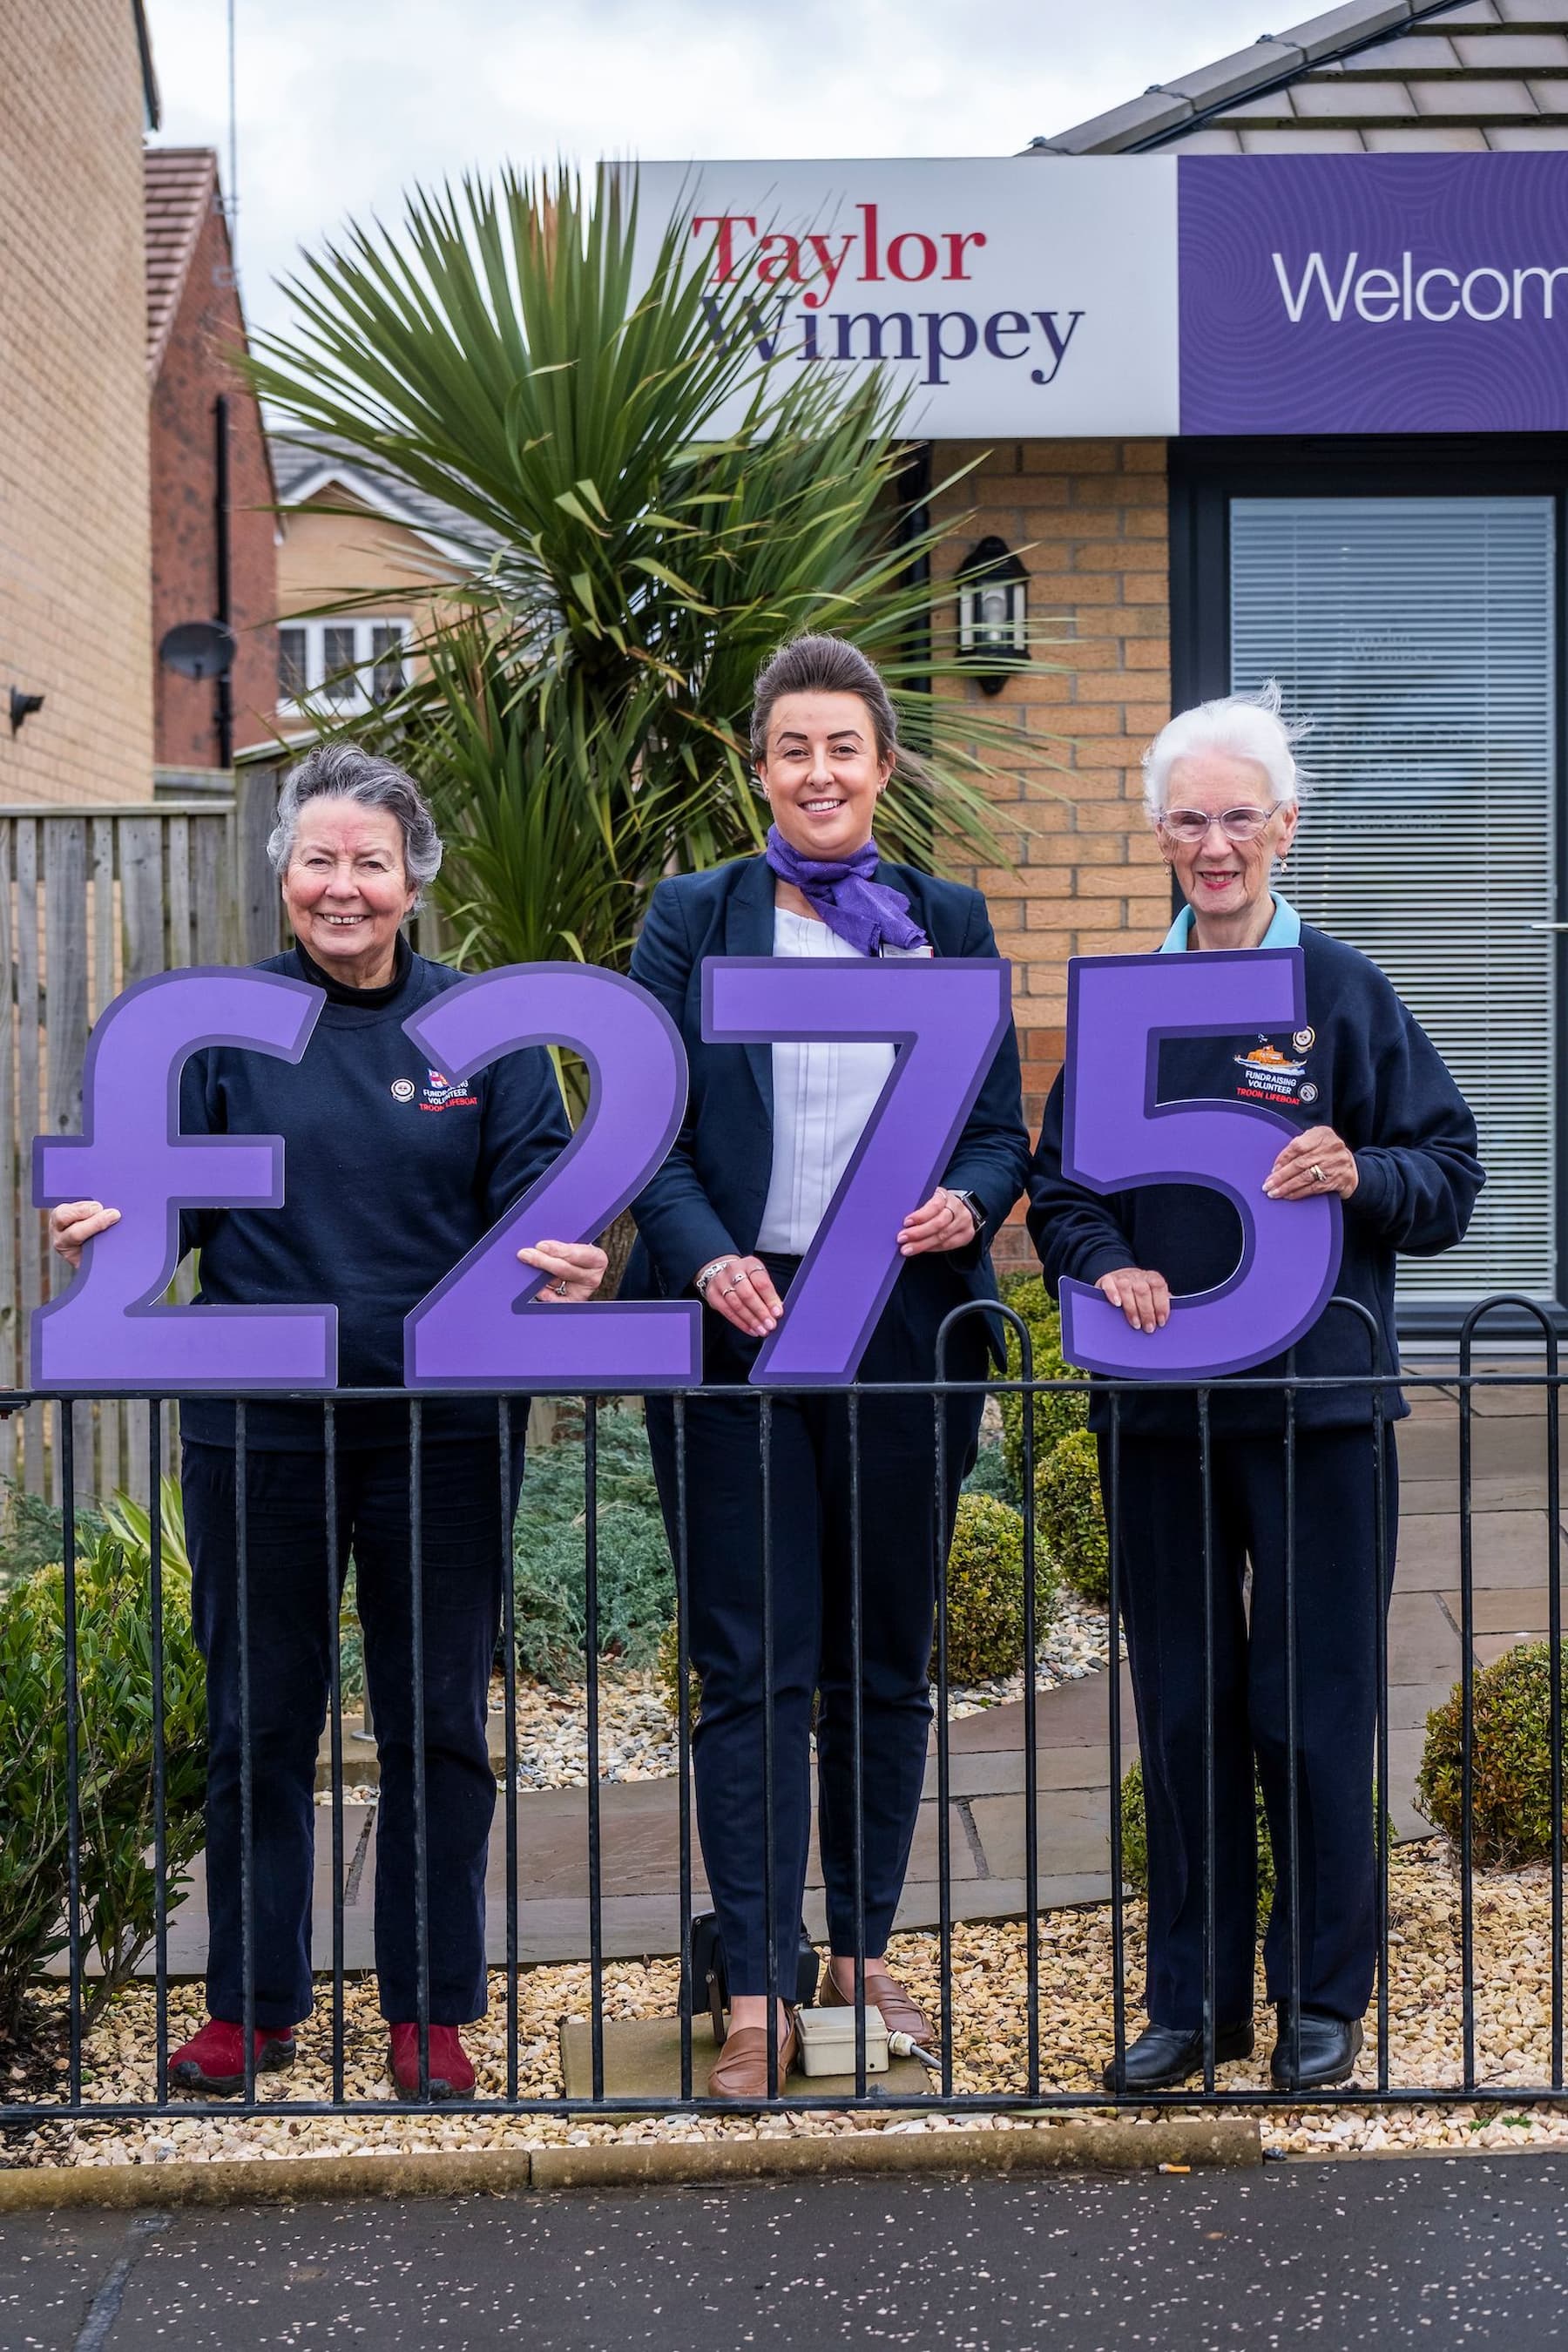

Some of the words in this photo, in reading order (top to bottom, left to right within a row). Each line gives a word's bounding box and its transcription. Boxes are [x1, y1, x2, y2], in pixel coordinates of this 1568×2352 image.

[692, 203, 987, 308] Taylor
[1272, 251, 1568, 322] Welcom
[700, 295, 1085, 385] Wimpey
[1237, 1087, 1263, 1098] TROON
[1265, 1092, 1301, 1105] LIFEBOAT
[1245, 1070, 1297, 1087] FUNDRAISING
[1247, 1079, 1293, 1095] VOLUNTEER
[445, 1097, 477, 1106] LIFEBOAT
[32, 948, 1344, 1389] £275
